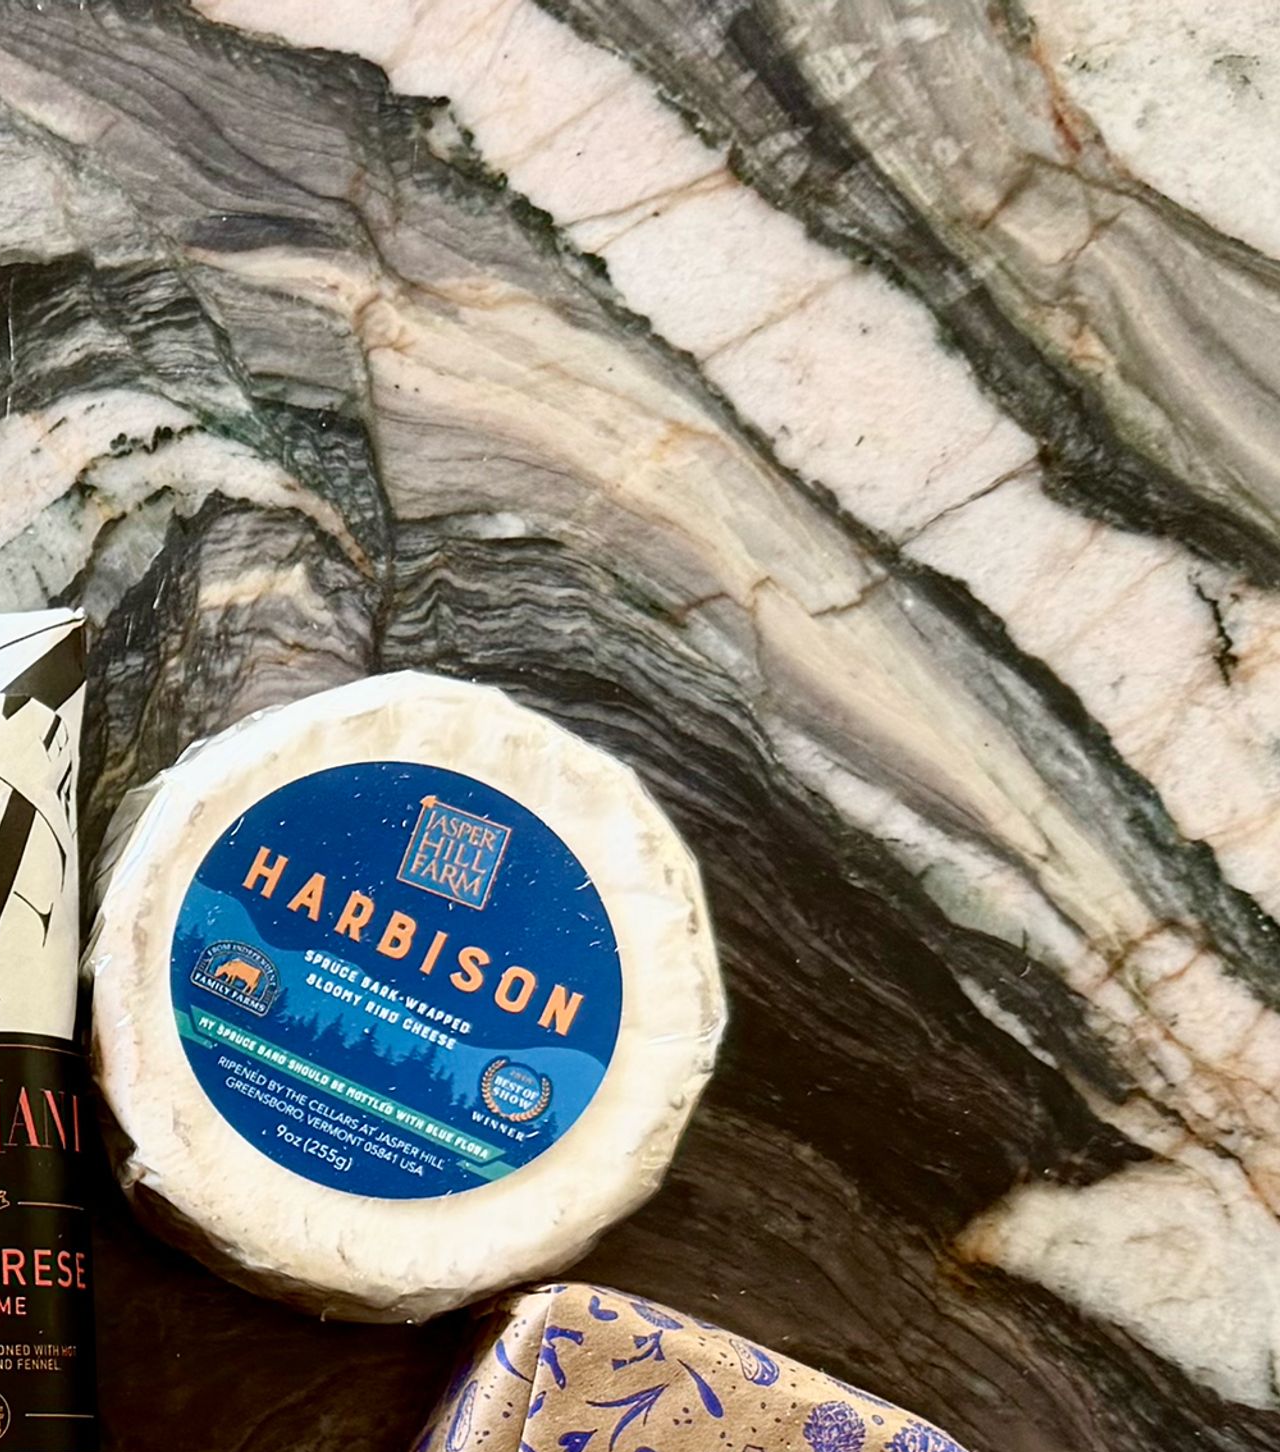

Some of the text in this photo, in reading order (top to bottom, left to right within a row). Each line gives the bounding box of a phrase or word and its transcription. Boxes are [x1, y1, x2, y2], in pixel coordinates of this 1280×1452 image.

[418, 830, 487, 875] HILL
[425, 810, 497, 852] JASPER
[409, 851, 482, 898] FARM
[241, 845, 585, 1036] HARBISON
[304, 949, 471, 1034] SPRUCE BARK-WRAPPED
[305, 972, 457, 1050] BLOOMY RIND CHEESE
[198, 1016, 489, 1159] MY SPRUCE BAND SHOULD BE MOTTLED WITH BLUE FLORA
[276, 1124, 353, 1172] 9oz (255g)
[471, 1110, 525, 1142] WINNER
[17, 1358, 60, 1369] FENNEL
[34, 1345, 59, 1356] WITH
